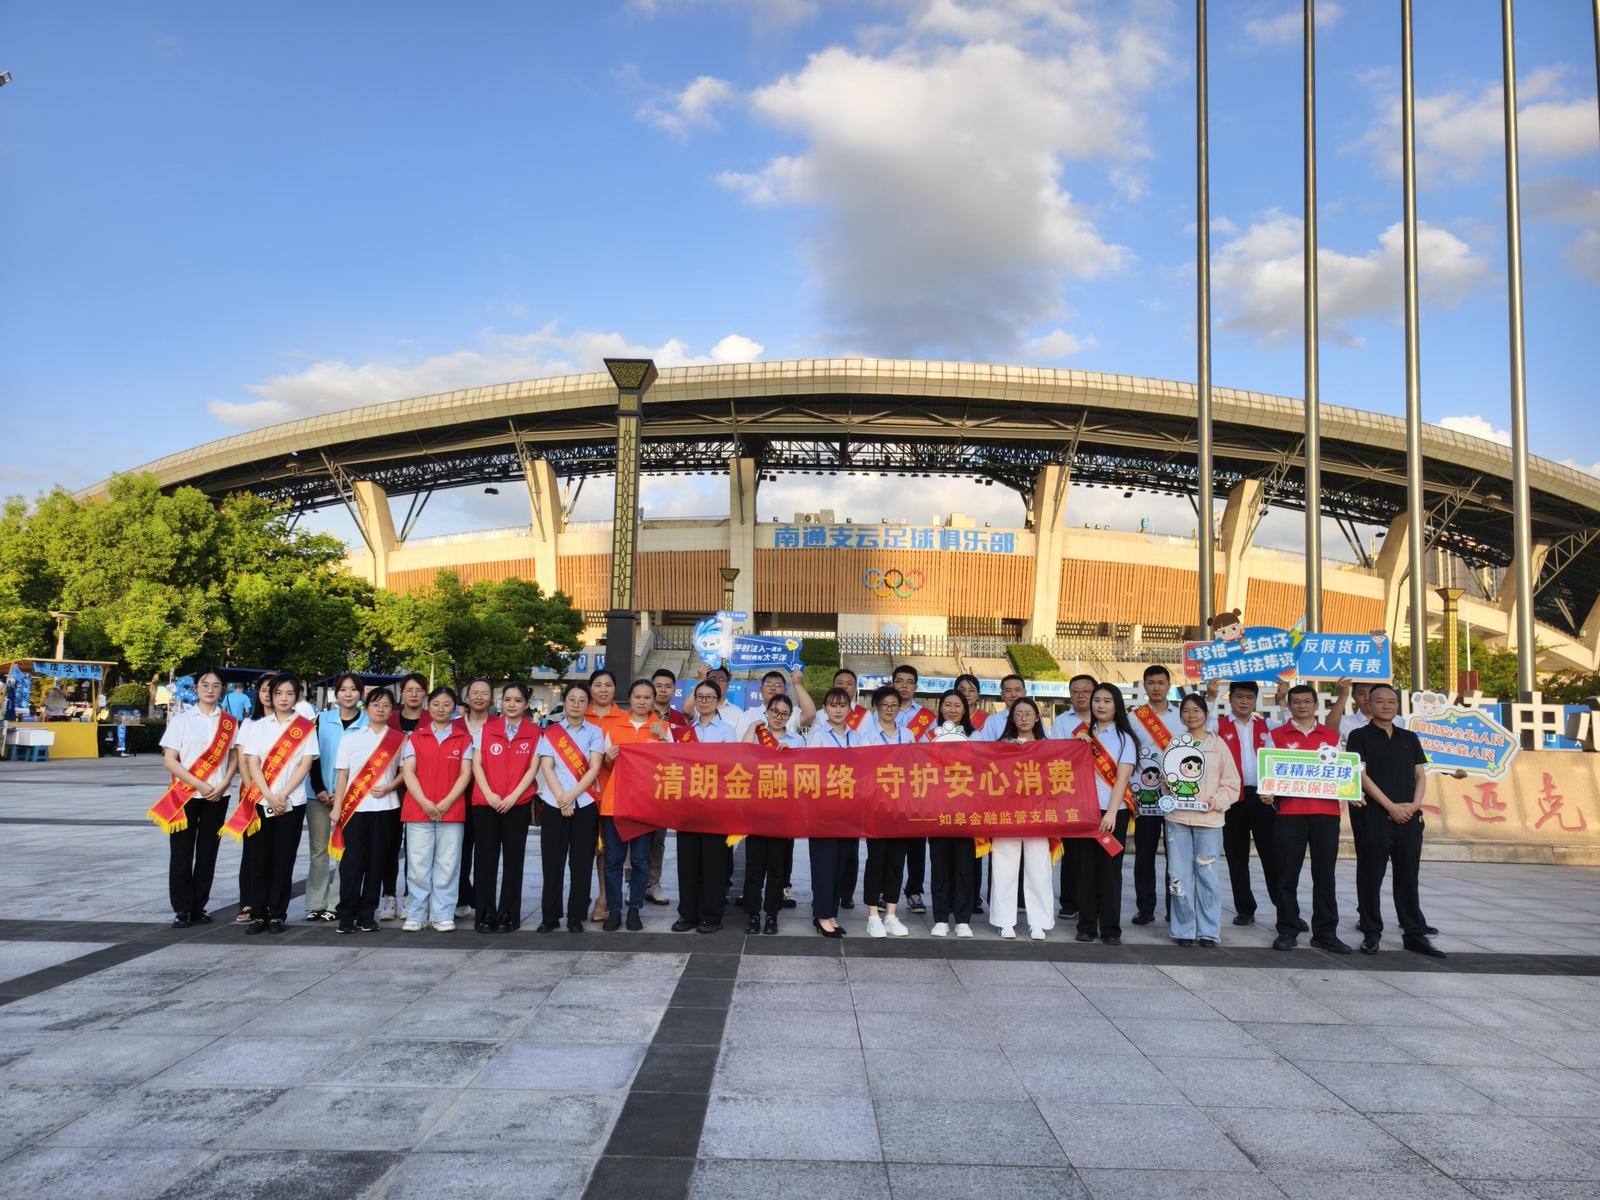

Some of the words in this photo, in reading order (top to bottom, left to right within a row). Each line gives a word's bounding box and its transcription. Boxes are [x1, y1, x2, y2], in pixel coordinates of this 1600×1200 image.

[774, 526, 1015, 553] 南通支云足球俱乐部
[1194, 632, 1288, 660] 珍惜一生血汗
[1303, 638, 1370, 654] 反假货币
[1201, 652, 1296, 680] 远离非法集资
[1313, 657, 1383, 675] 人人有责
[653, 762, 857, 800] 清朗金融网络
[876, 759, 1077, 799] 守护安心消费
[1274, 762, 1353, 780] 看精彩足球
[1065, 808, 1081, 824] 宣
